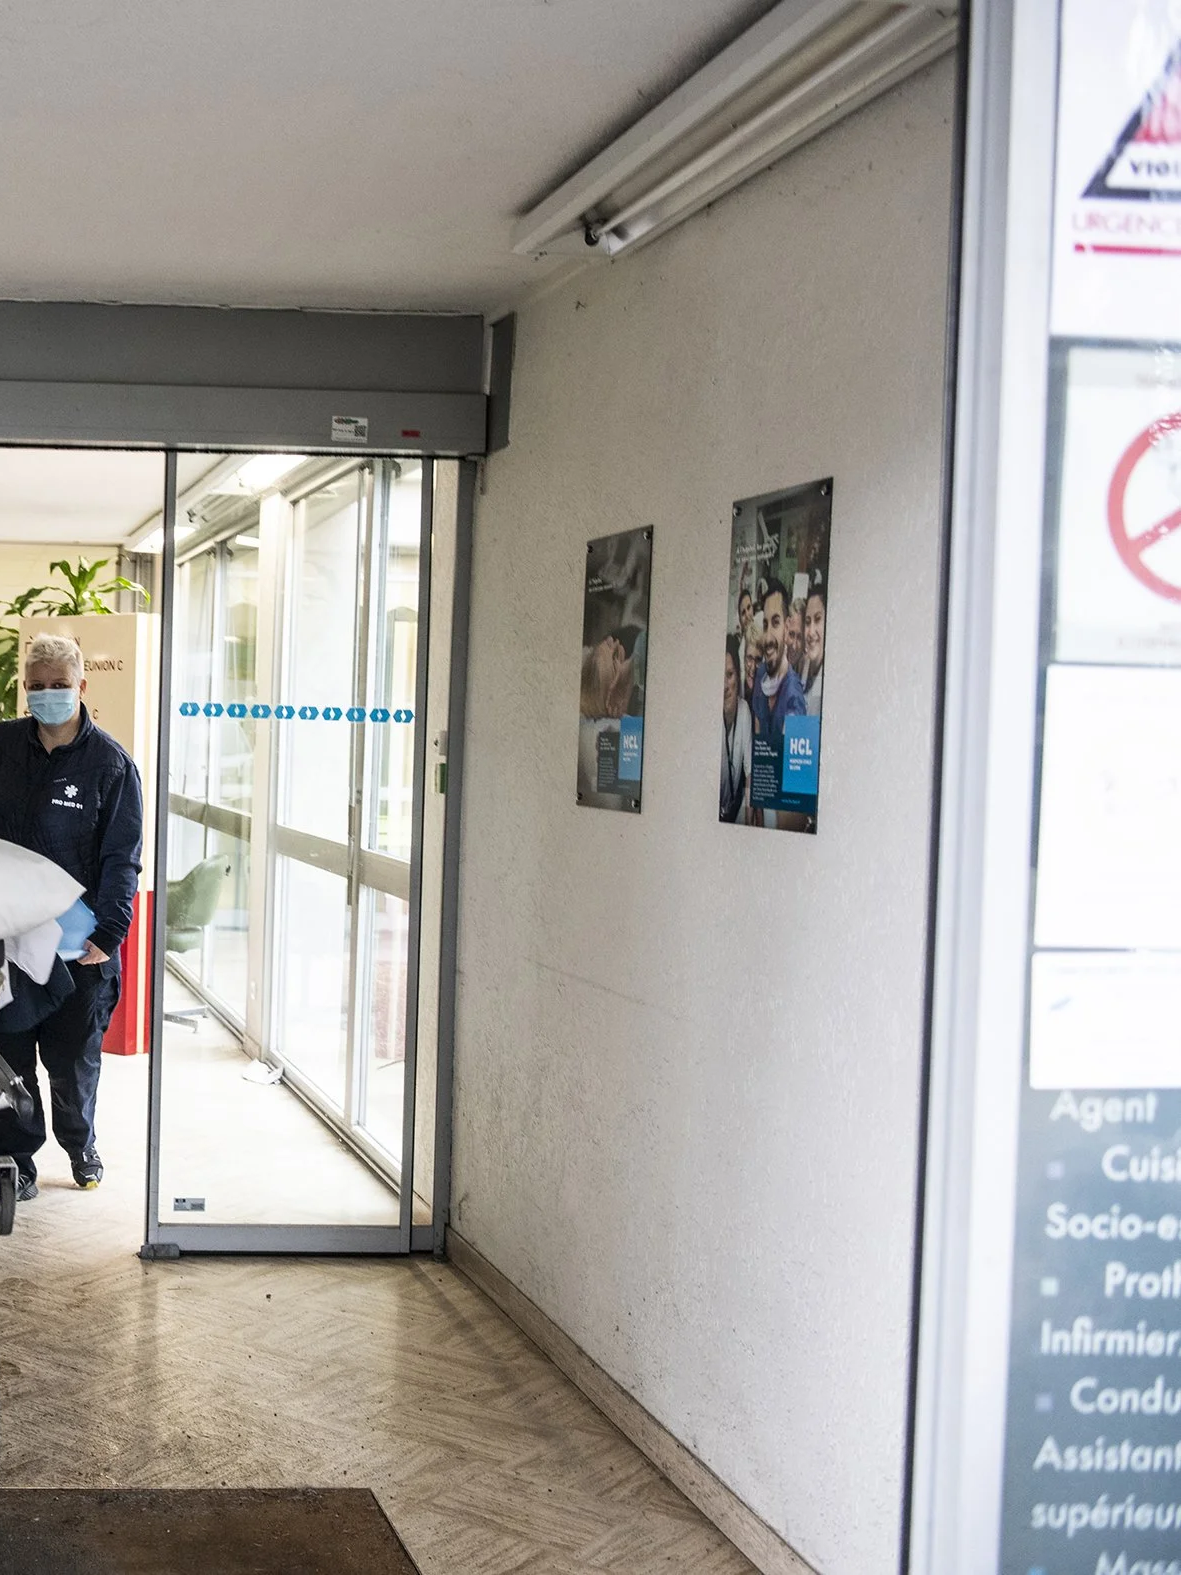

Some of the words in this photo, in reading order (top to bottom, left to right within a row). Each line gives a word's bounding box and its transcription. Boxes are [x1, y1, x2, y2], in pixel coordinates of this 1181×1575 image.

[1071, 211, 1181, 236] URGENC
[116, 659, 124, 671] C
[789, 737, 813, 756] HCL
[1048, 1090, 1157, 1133] Agent
[1044, 1201, 1181, 1240] Socio-e
